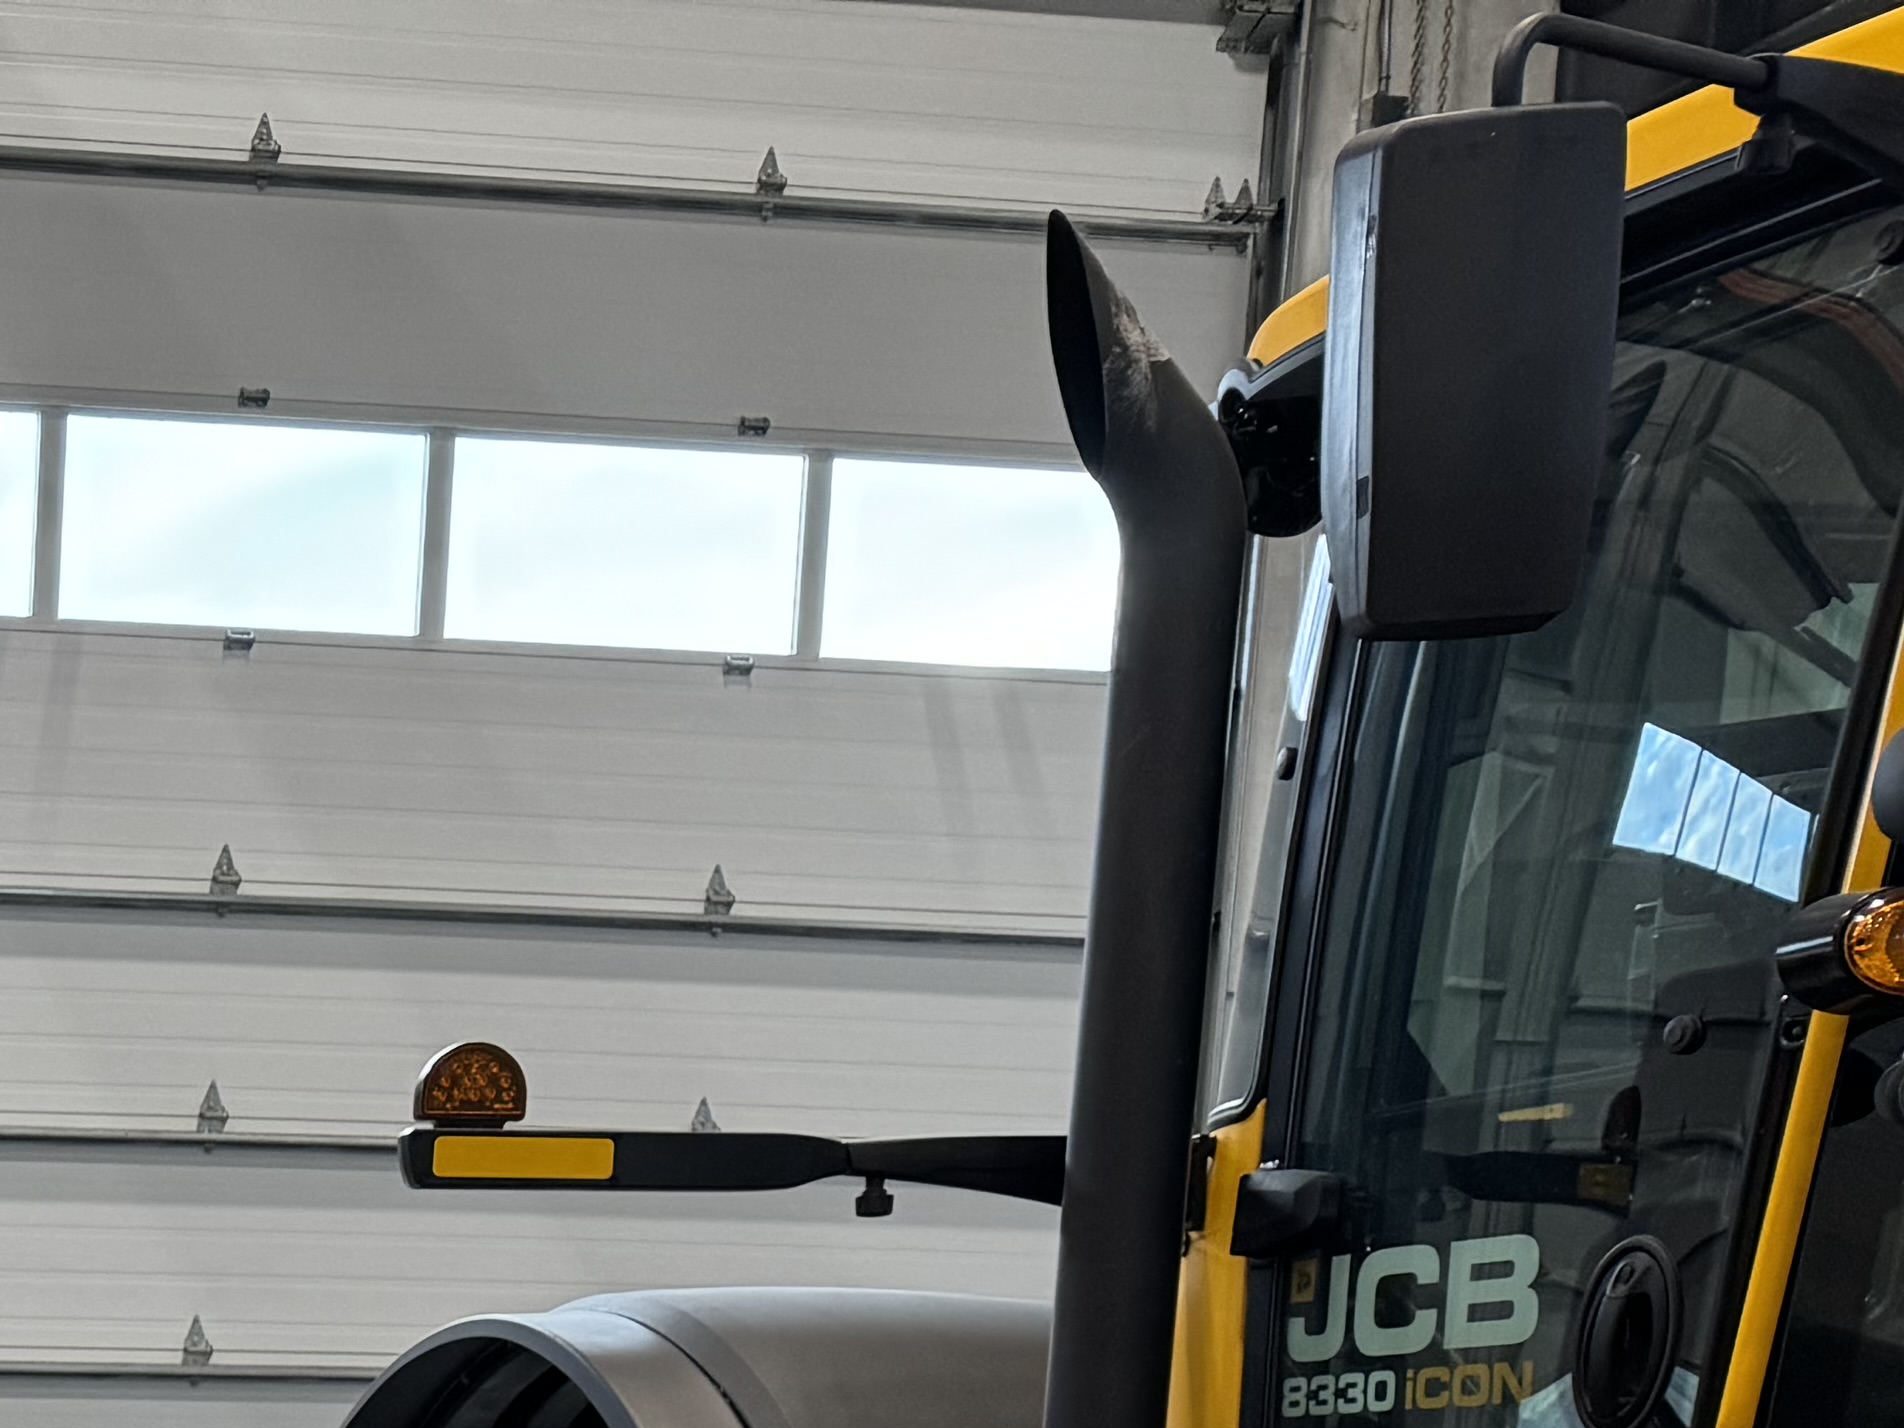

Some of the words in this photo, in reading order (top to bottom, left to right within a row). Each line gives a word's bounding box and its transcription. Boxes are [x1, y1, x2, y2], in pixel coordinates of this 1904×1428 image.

[1287, 1234, 1540, 1362] JCB
[1282, 1369, 1396, 1418] 8330
[1405, 1359, 1534, 1411] iCON
